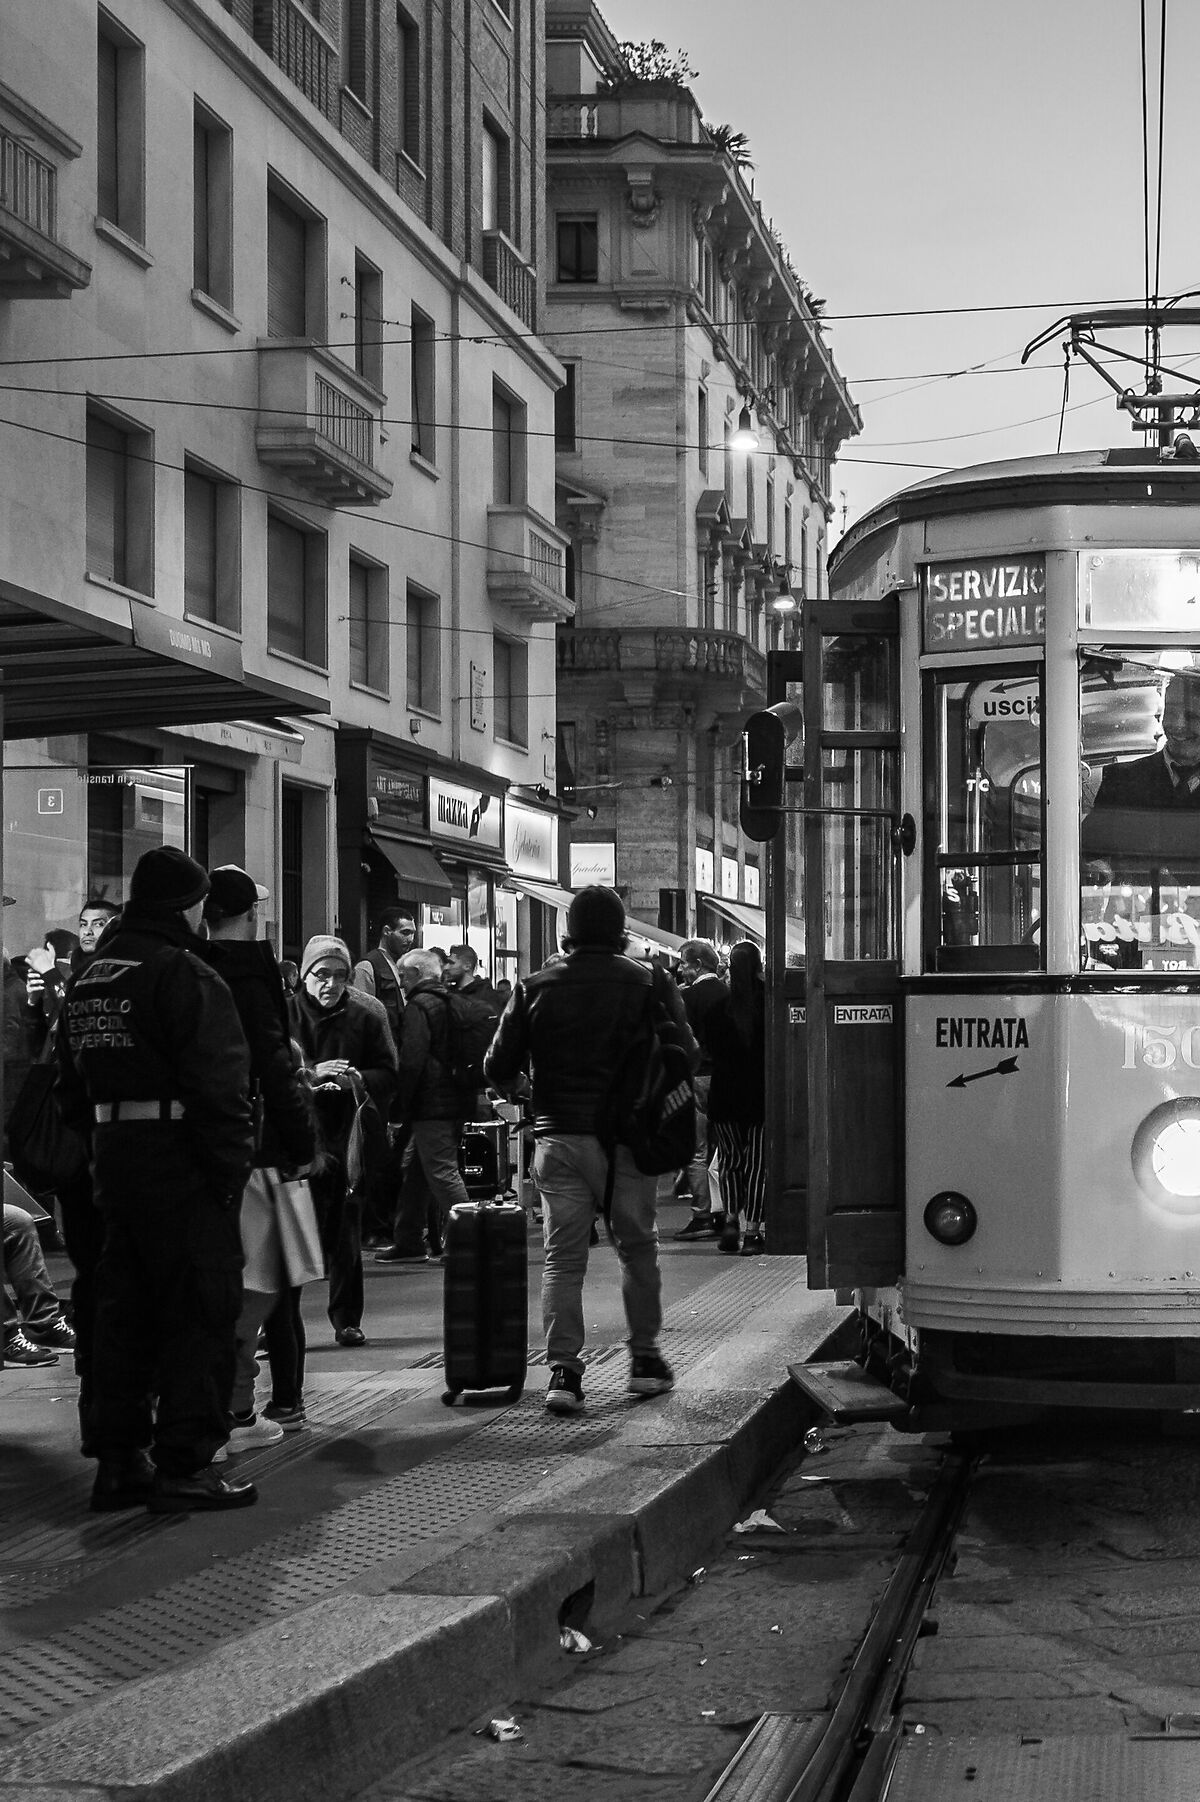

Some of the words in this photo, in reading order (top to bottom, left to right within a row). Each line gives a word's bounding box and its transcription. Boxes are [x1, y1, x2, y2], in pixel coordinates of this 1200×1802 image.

[933, 565, 1045, 602] SERVIZIO
[931, 605, 1045, 641] SPECIALE
[836, 1007, 892, 1021] ENTRATA
[936, 1018, 1030, 1049] ENTRATA
